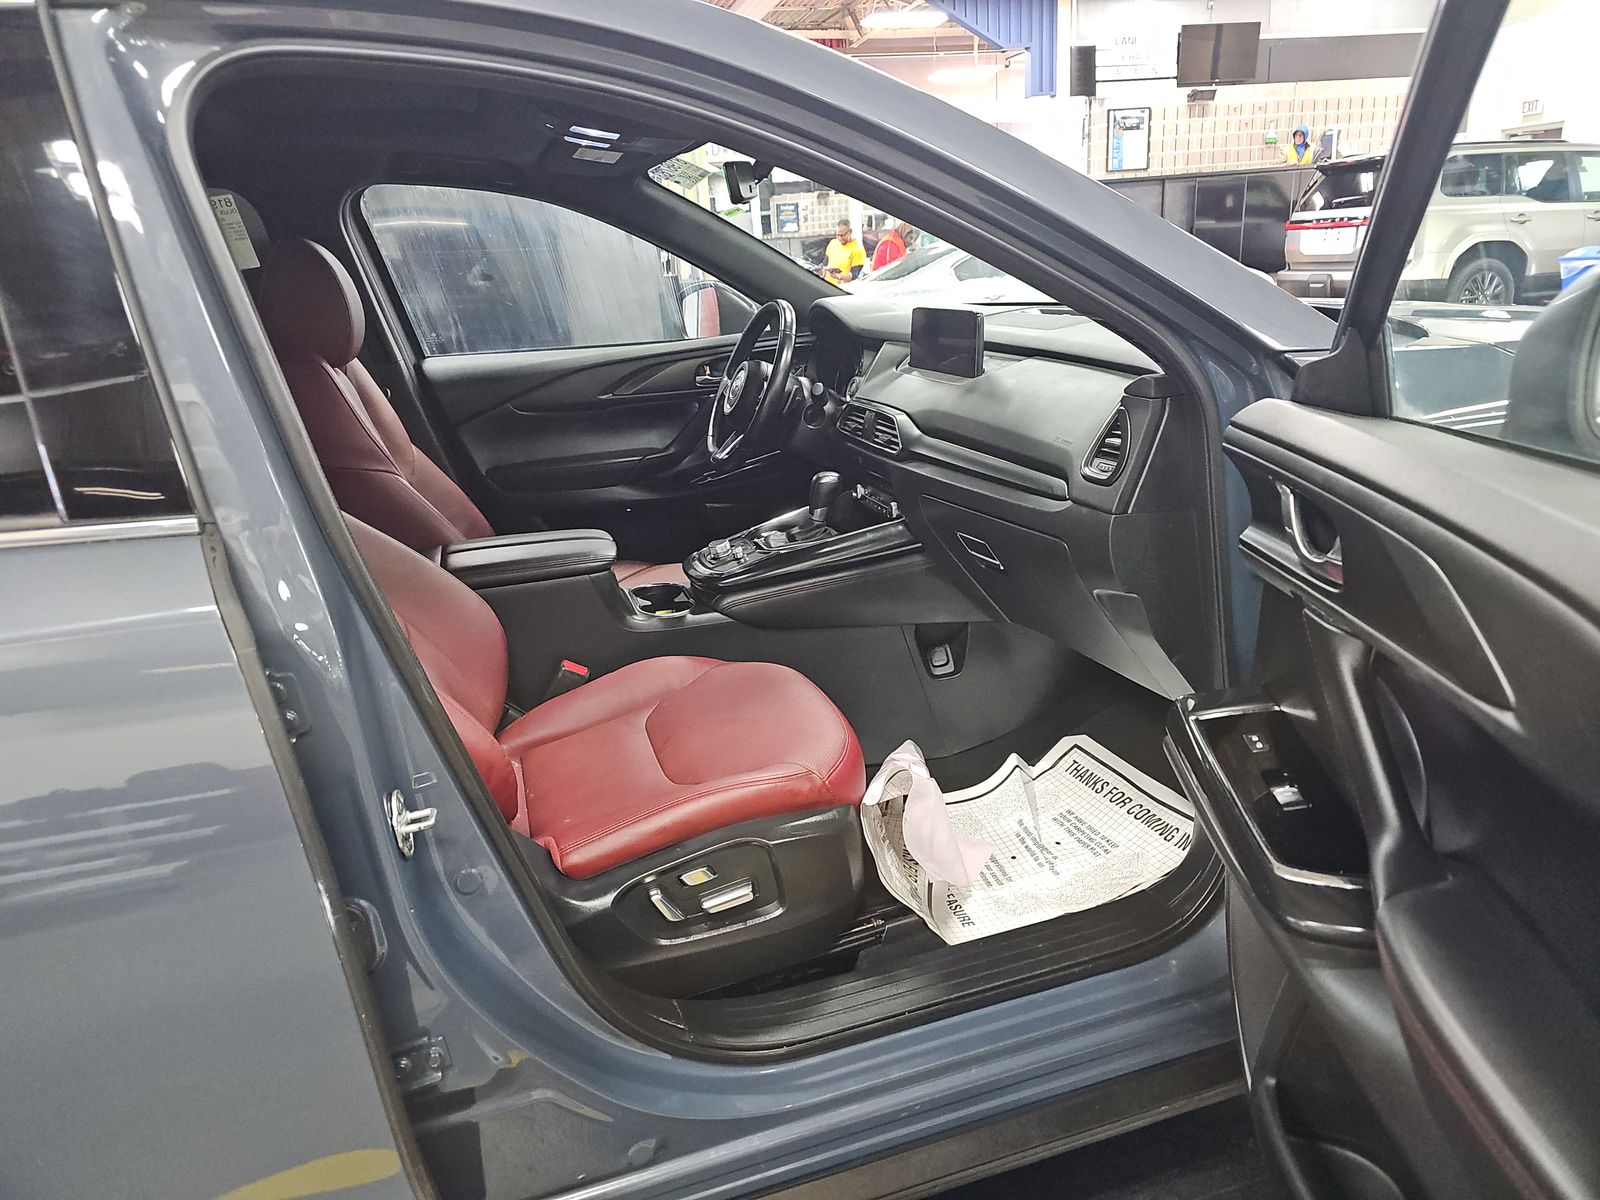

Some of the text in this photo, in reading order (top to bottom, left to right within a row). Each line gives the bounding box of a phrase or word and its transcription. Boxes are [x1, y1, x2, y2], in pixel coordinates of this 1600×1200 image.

[1522, 100, 1540, 113] EXIT
[1065, 760, 1192, 852] THANKS FOR COMING IN
[946, 888, 976, 928] EASURE
